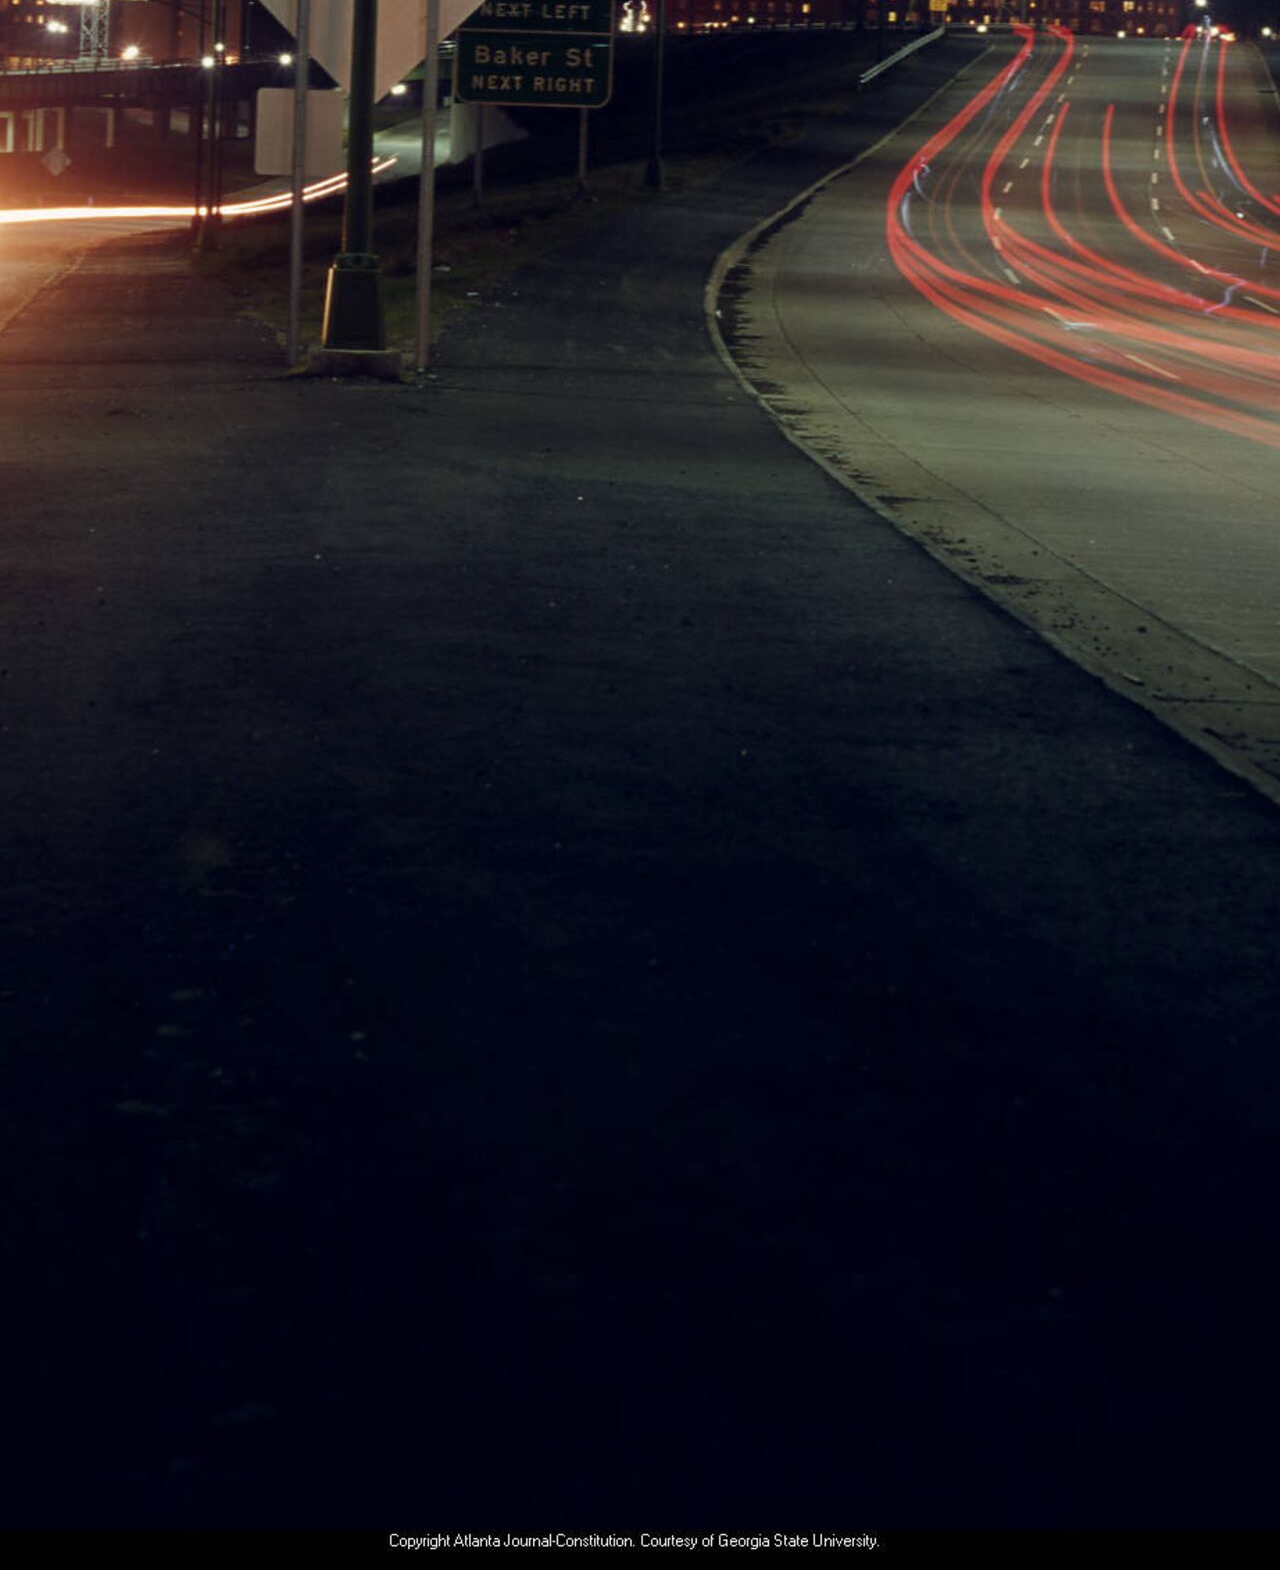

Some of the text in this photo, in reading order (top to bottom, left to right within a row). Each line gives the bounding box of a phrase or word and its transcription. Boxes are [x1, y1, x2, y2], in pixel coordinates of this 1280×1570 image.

[480, 2, 593, 20] NEXT LEFT
[474, 44, 595, 69] Baker St
[472, 74, 595, 94] NEXT RIGHT
